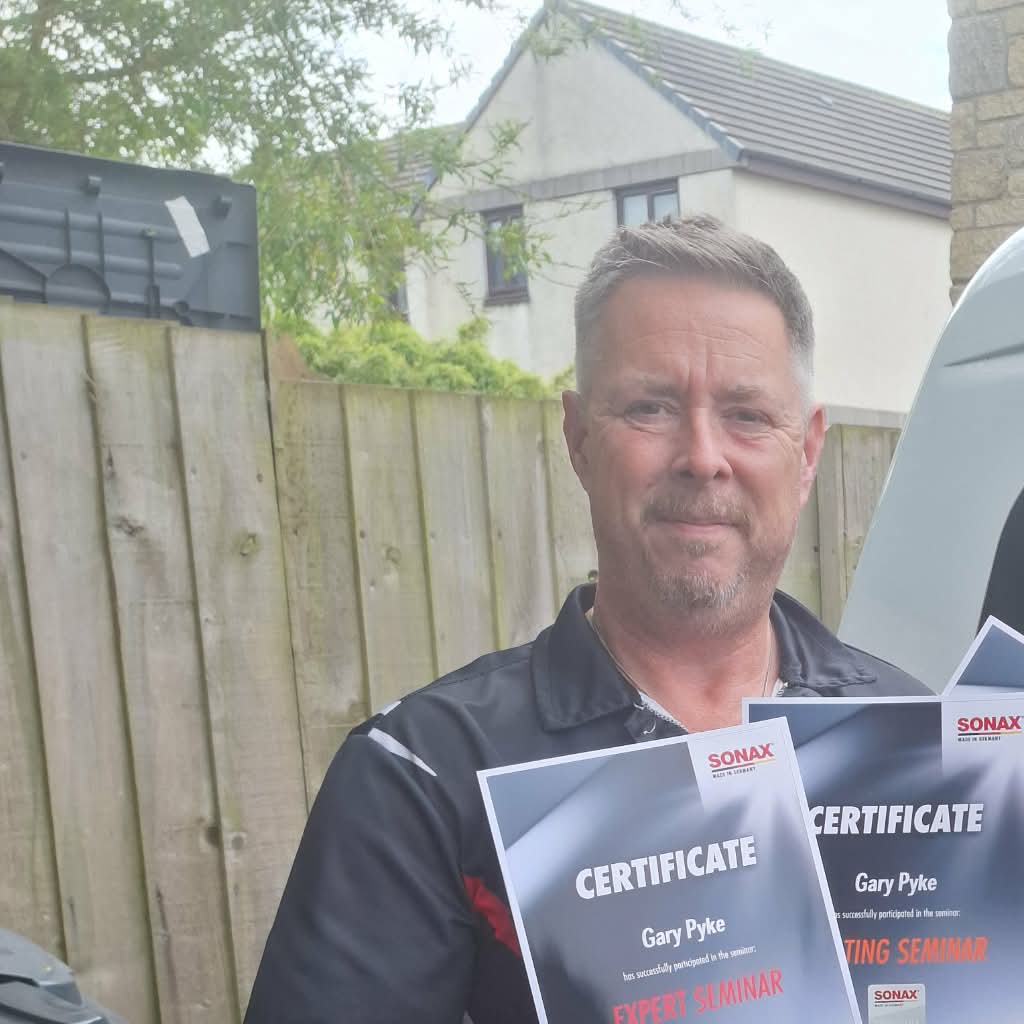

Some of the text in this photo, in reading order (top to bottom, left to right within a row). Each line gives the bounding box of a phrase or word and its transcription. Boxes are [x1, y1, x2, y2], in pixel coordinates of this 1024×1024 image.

[957, 715, 1022, 732] SONAX
[707, 742, 775, 769] SONAX
[808, 803, 985, 835] CERTIFICATE
[575, 835, 758, 900] CERTIFICATE
[855, 871, 938, 897] Gary Pyke
[842, 908, 878, 921] successfully
[878, 908, 914, 921] participated
[915, 907, 922, 918] in
[923, 907, 934, 918] the
[641, 917, 727, 949] Gary Pyke
[622, 971, 635, 981] has
[636, 962, 673, 979] successfully
[673, 953, 710, 973] participated
[718, 949, 730, 960] the
[896, 935, 988, 965] SEMINAR
[693, 968, 784, 1015] SEMINAR
[874, 989, 918, 1001] SONAX
